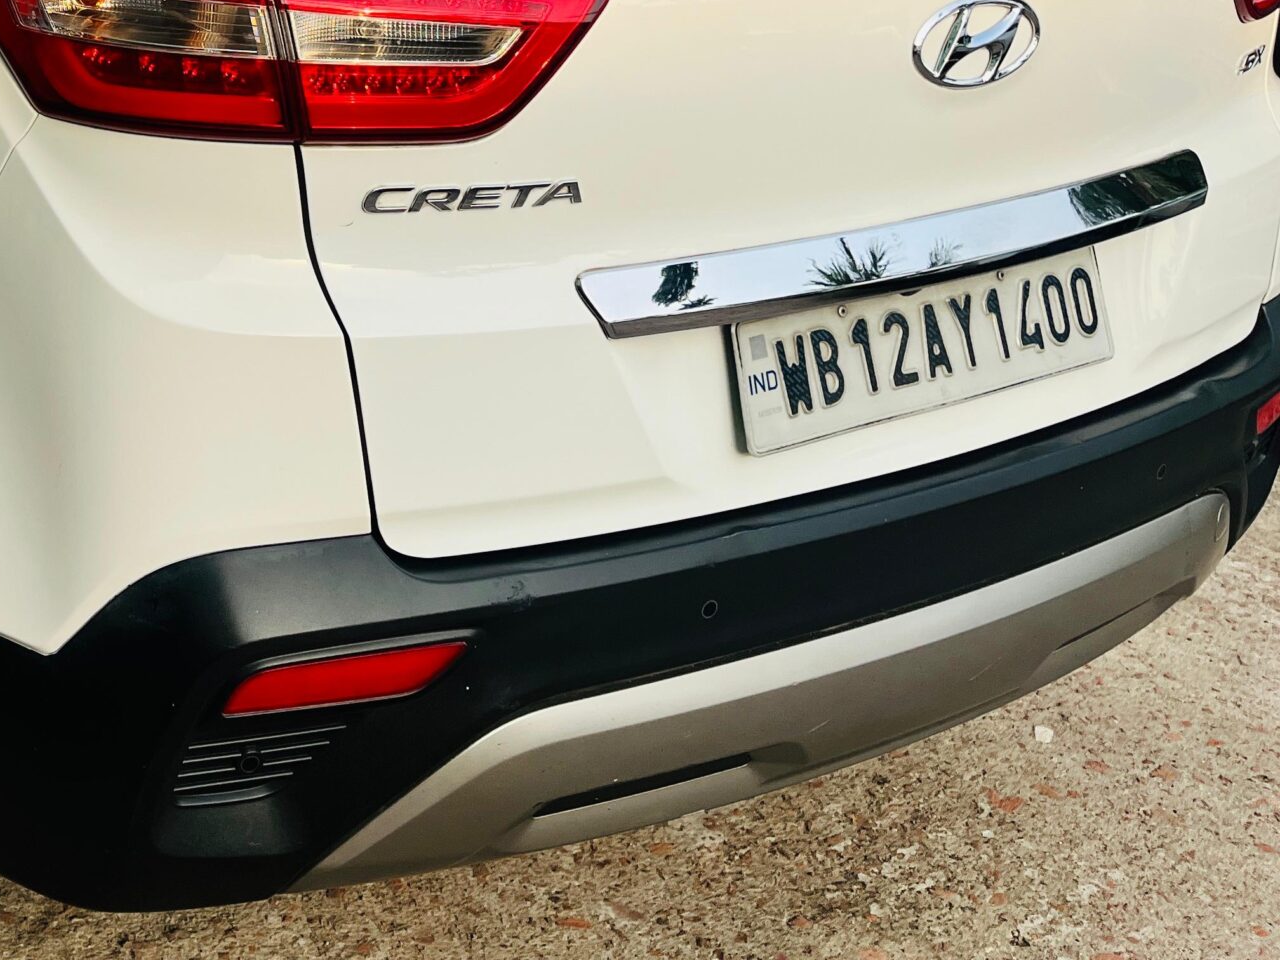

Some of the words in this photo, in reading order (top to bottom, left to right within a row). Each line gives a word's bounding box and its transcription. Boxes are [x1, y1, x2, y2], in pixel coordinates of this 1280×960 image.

[361, 178, 582, 214] CRETA
[772, 266, 1099, 417] WB12AY1400
[748, 369, 778, 395] IND
